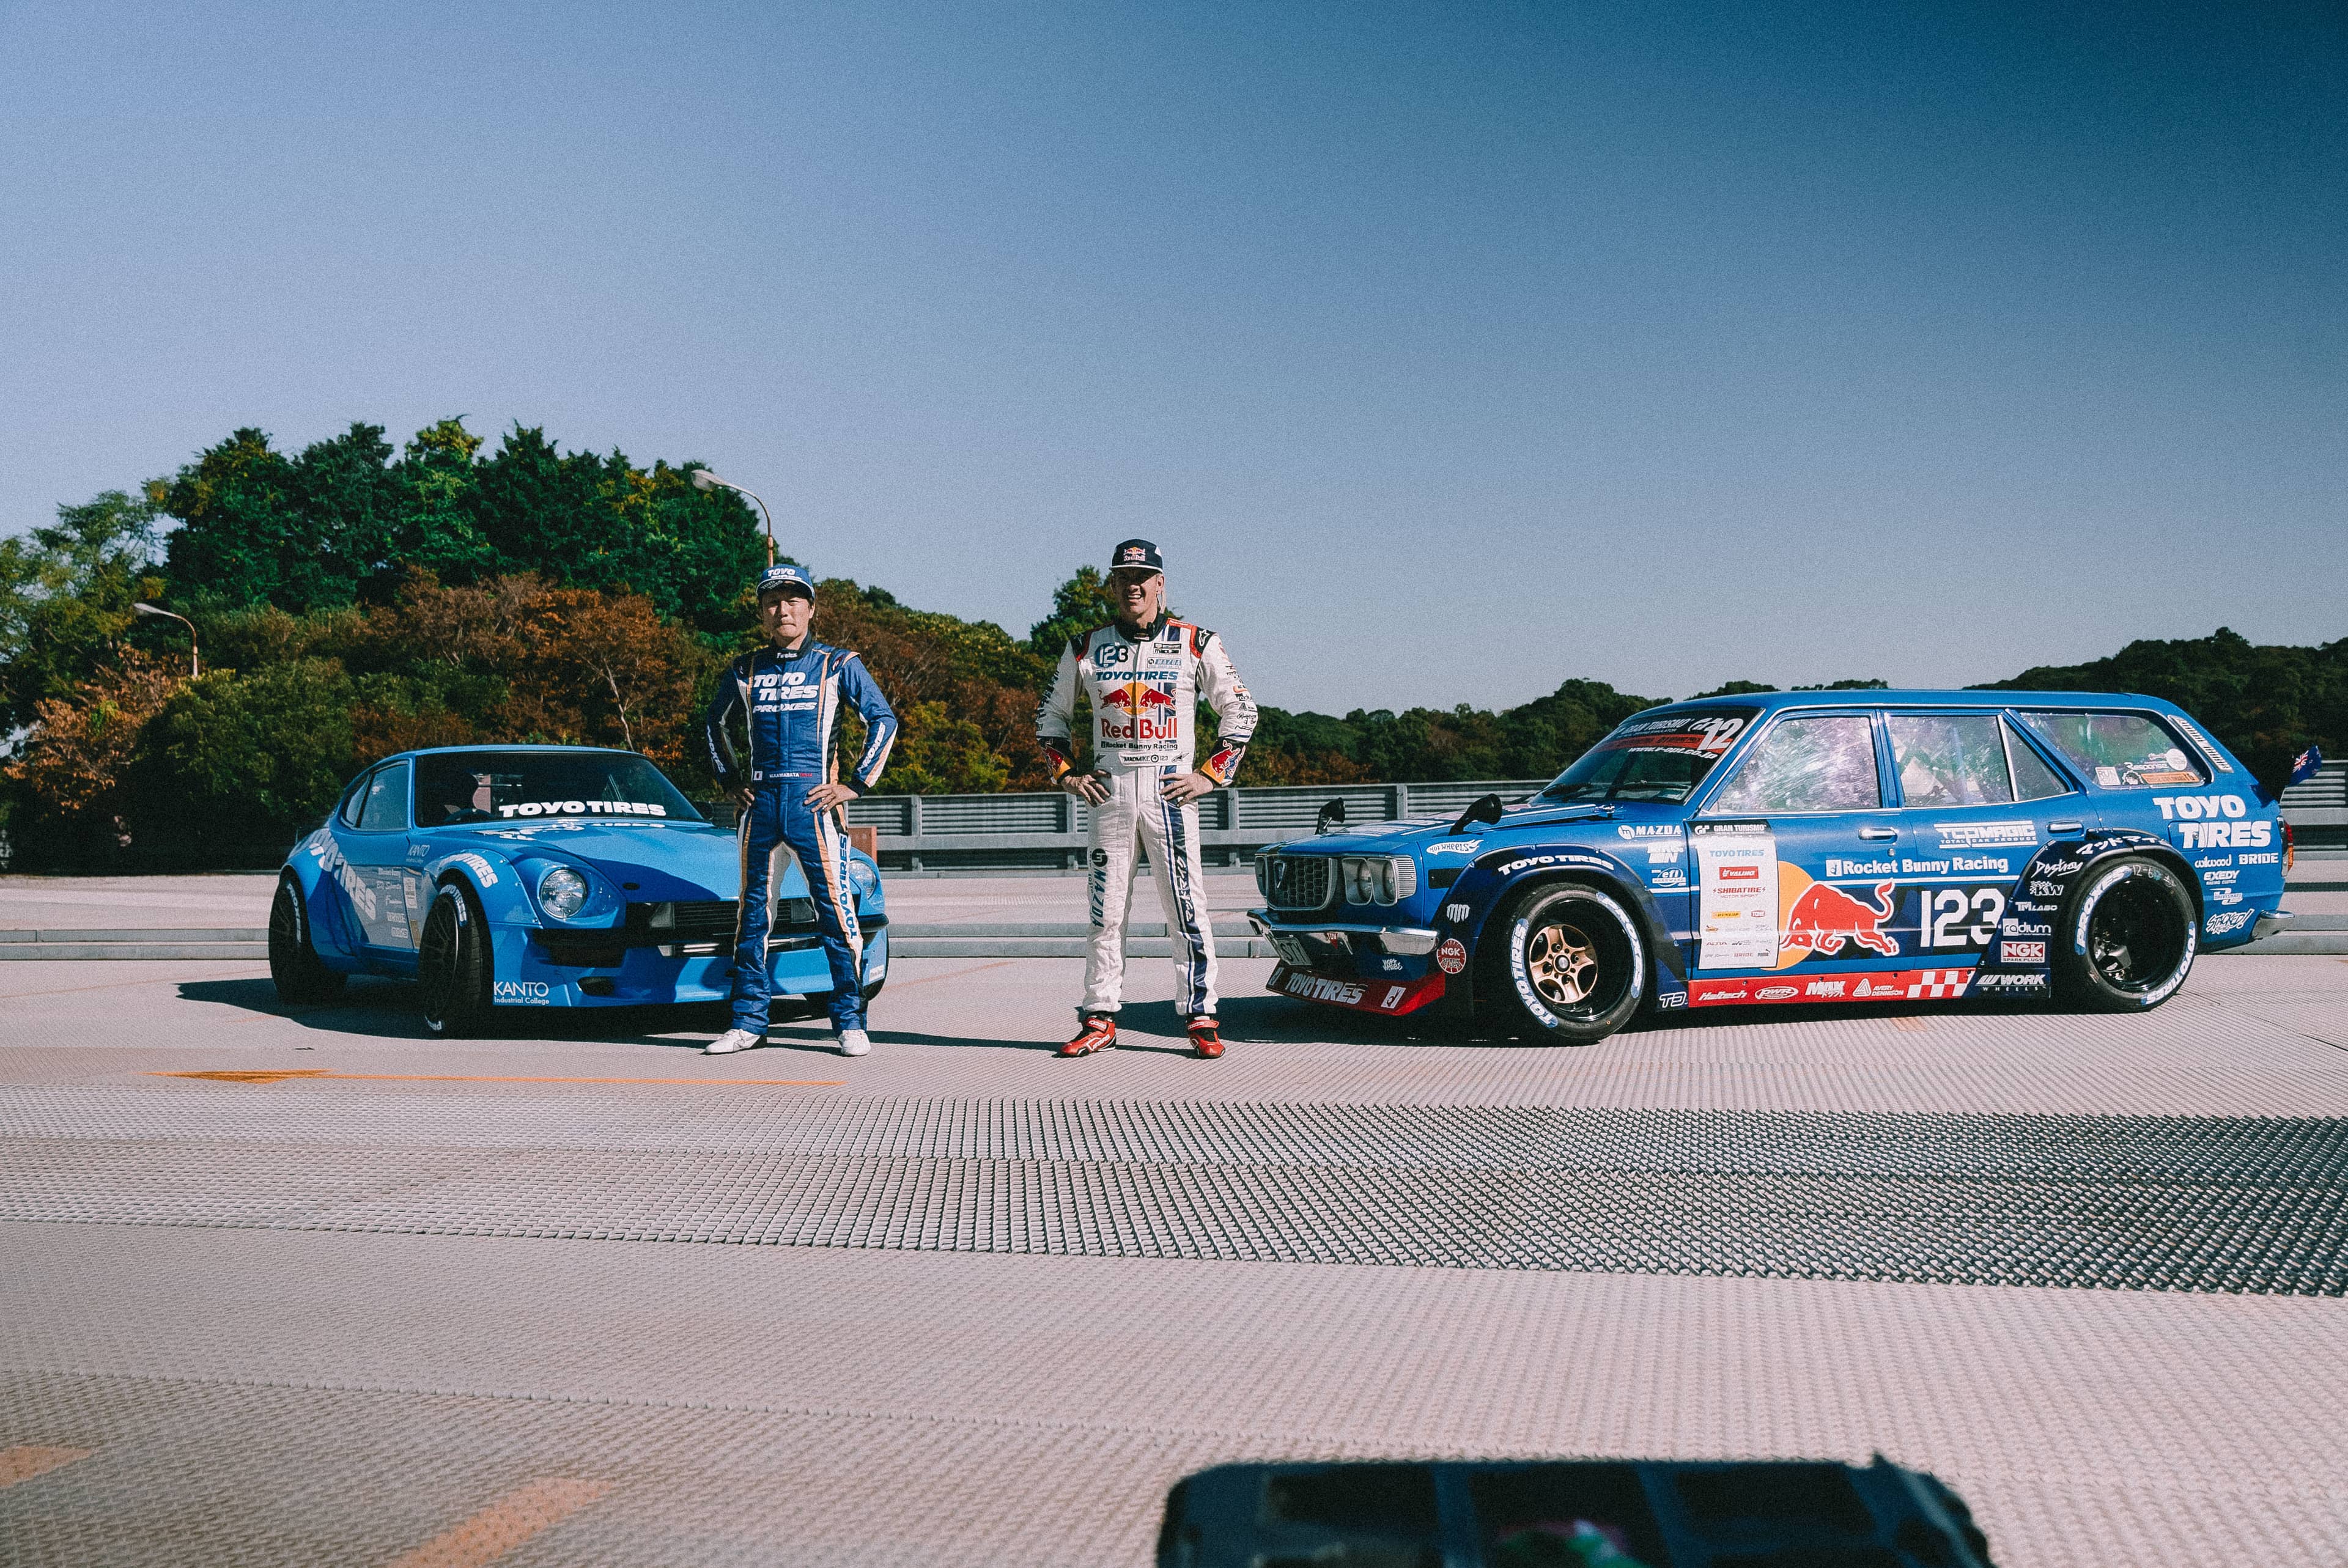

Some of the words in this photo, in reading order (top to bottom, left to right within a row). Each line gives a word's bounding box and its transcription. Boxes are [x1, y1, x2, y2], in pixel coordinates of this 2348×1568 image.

[767, 567, 796, 577] TOYO
[1099, 646, 1129, 665] 123
[753, 672, 807, 688] TOYO
[1096, 671, 1134, 681] TOYO
[1136, 671, 1178, 680] TIRES
[759, 685, 819, 701] TIRES
[753, 702, 818, 713] PROXES
[1101, 718, 1135, 739] Red
[1139, 718, 1178, 739] Bull
[499, 801, 585, 818] TOYO
[586, 801, 667, 816] TIRES
[2152, 795, 2246, 820] TOYO
[1636, 825, 1683, 836] MAZDA
[2179, 820, 2272, 849] TIRES
[408, 845, 430, 857] KANTO
[1442, 843, 1469, 852] WHEELS
[839, 835, 847, 892] TIRES
[1498, 857, 1554, 875] TOYO
[1555, 855, 1614, 870] TIRES
[1843, 859, 1898, 874] Rocket
[1902, 858, 1950, 874] Bunny
[1953, 856, 2009, 873] Racing
[2195, 854, 2232, 868] wilwood
[2239, 853, 2279, 865] BRIDE
[2204, 870, 2241, 880] EXEDY
[1092, 868, 1107, 928] MAZDA
[2036, 885, 2064, 896] KW
[2076, 865, 2130, 948] PROXES
[840, 893, 857, 940] TOYO
[1921, 888, 2005, 948] 123
[2004, 922, 2051, 933] radium
[1441, 947, 1461, 956] NGK
[1511, 923, 1526, 979] TIRES
[2003, 943, 2042, 957] NGK
[2180, 927, 2196, 971] TOYO
[1999, 974, 2045, 985] WORK
[493, 981, 549, 997] KANTO
[1285, 973, 1315, 997] TOYO
[1312, 978, 1365, 1004] TIRES
[1698, 990, 1748, 1001] Haltech
[1805, 981, 1846, 996] MAX
[2146, 972, 2183, 1005] TIRES
[525, 997, 550, 1006] College
[1515, 979, 1556, 1025] TOYO
